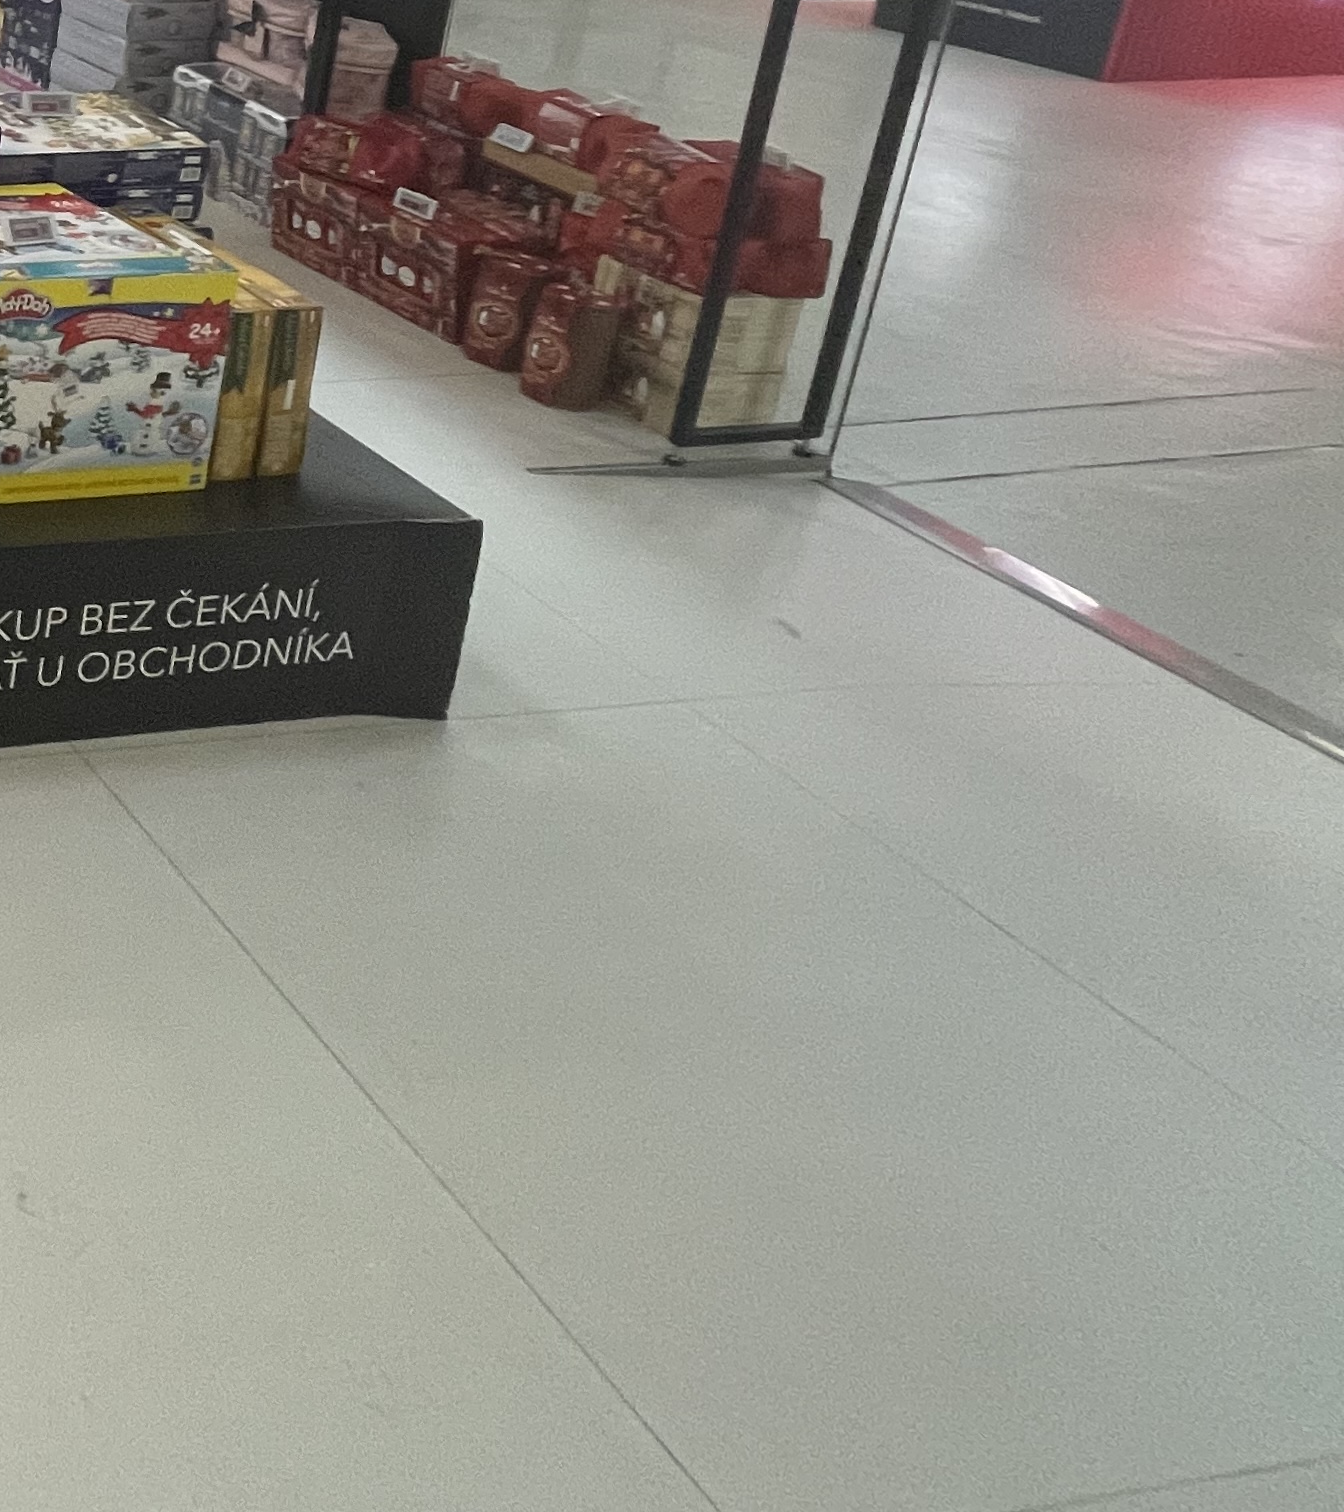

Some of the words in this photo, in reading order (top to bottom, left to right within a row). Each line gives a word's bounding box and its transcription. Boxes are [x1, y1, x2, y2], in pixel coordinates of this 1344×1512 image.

[188, 321, 221, 338] 24+
[79, 598, 157, 637] BEZ
[166, 578, 321, 629] ČEKÁNÍ,
[37, 655, 64, 688] U
[77, 627, 355, 685] OBCHODNÍKA
